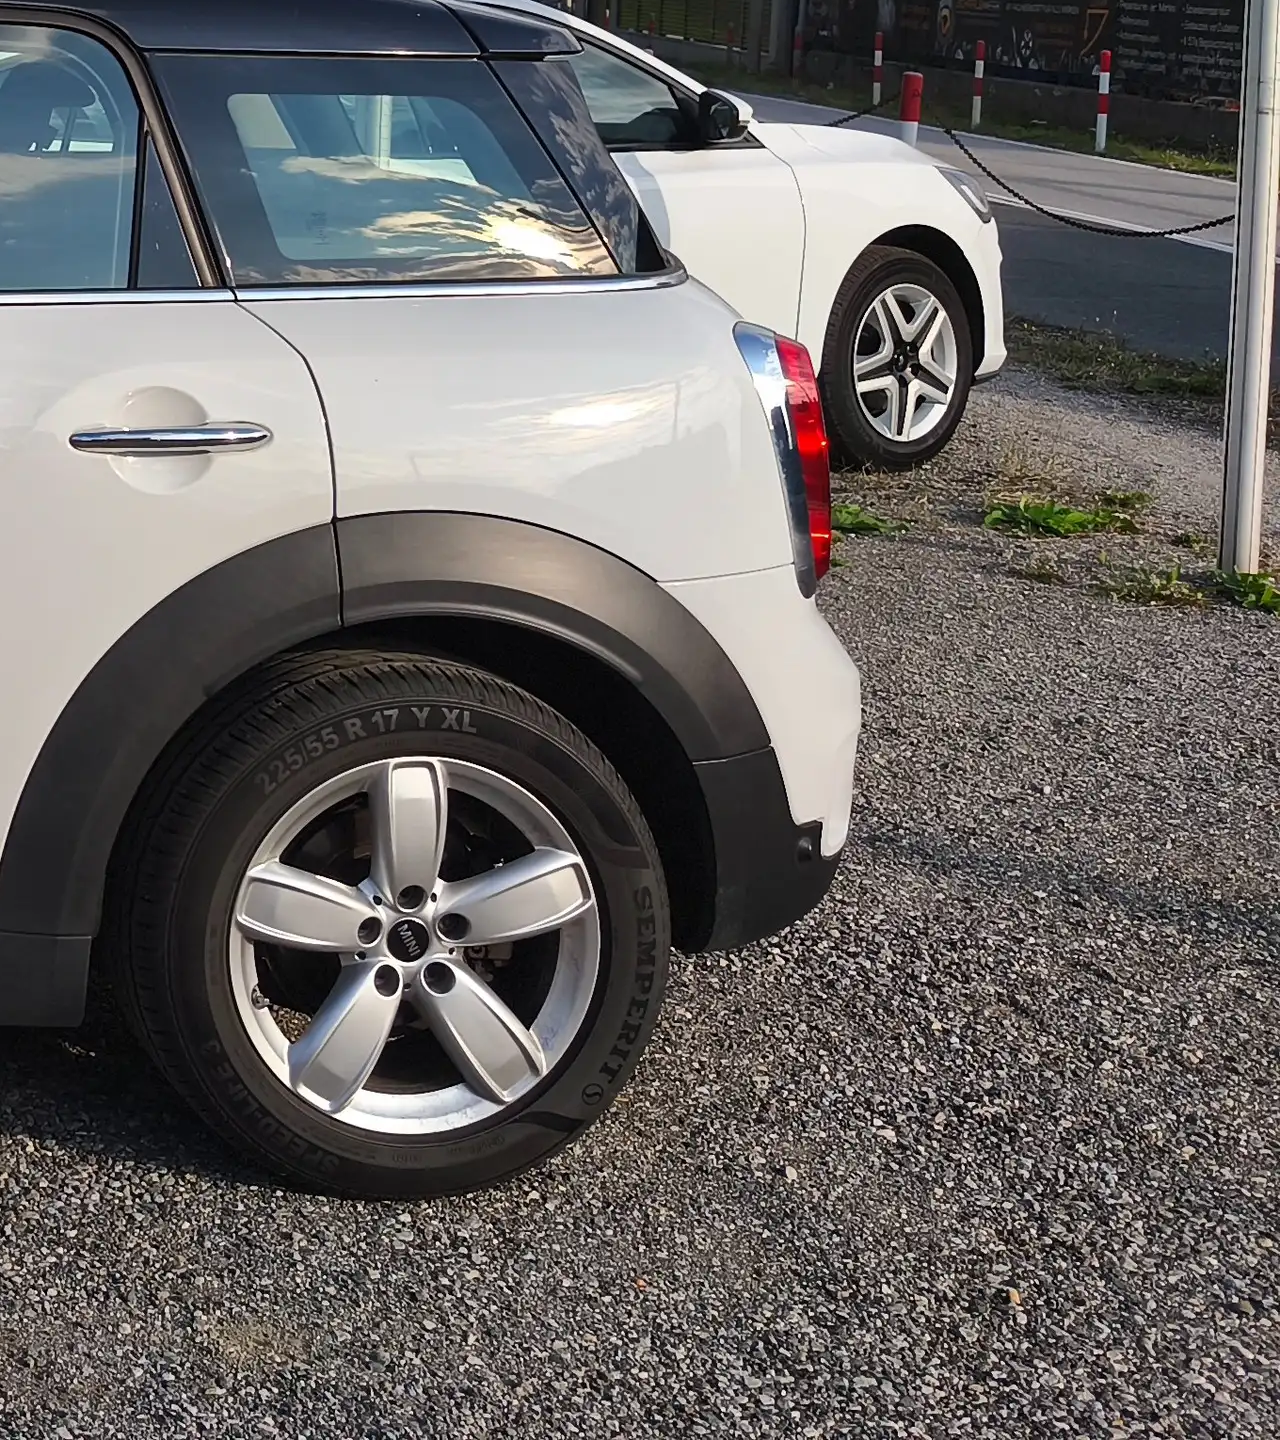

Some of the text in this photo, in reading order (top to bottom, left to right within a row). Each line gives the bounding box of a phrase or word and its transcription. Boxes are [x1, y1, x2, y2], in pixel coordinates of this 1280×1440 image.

[253, 707, 478, 796] 225/55 R 17 Y XL
[397, 923, 421, 957] MINI
[600, 885, 657, 1085] SEMPERIT
